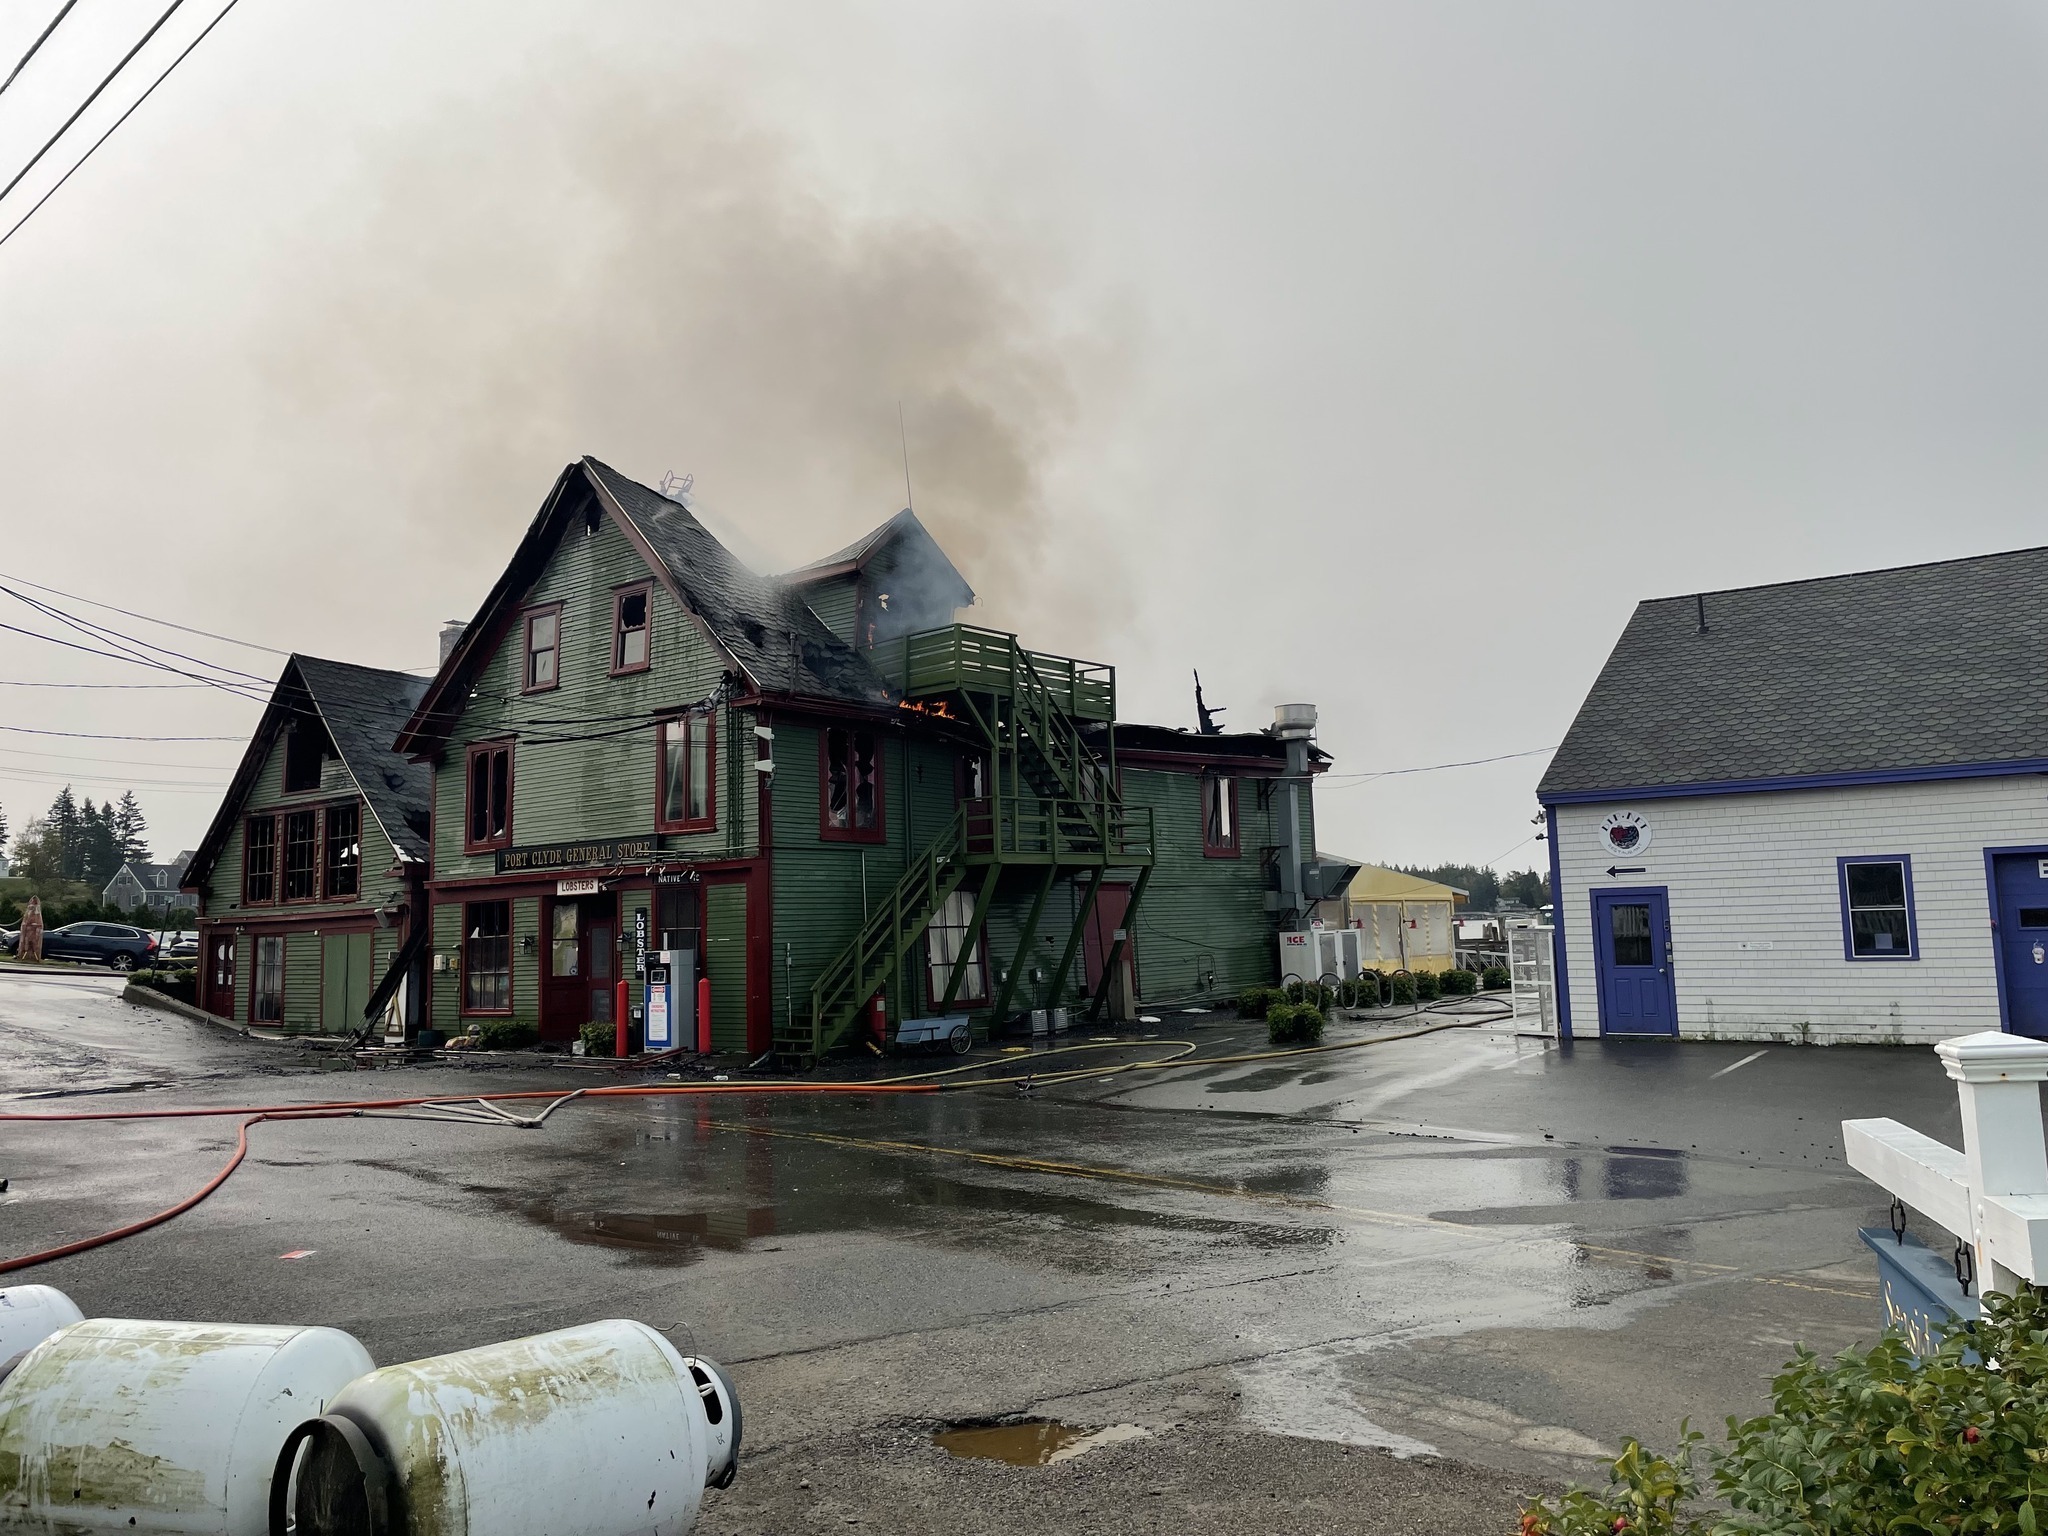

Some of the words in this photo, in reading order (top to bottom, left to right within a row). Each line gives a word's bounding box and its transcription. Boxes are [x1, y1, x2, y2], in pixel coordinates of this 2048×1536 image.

[504, 852, 528, 867] PORT
[531, 849, 562, 866] CLYDE
[566, 845, 613, 864] GENERAL
[617, 841, 650, 859] STORE
[561, 879, 594, 892] LOBSTERS
[658, 873, 681, 884] NATIVE
[636, 913, 645, 972] LOBSTER
